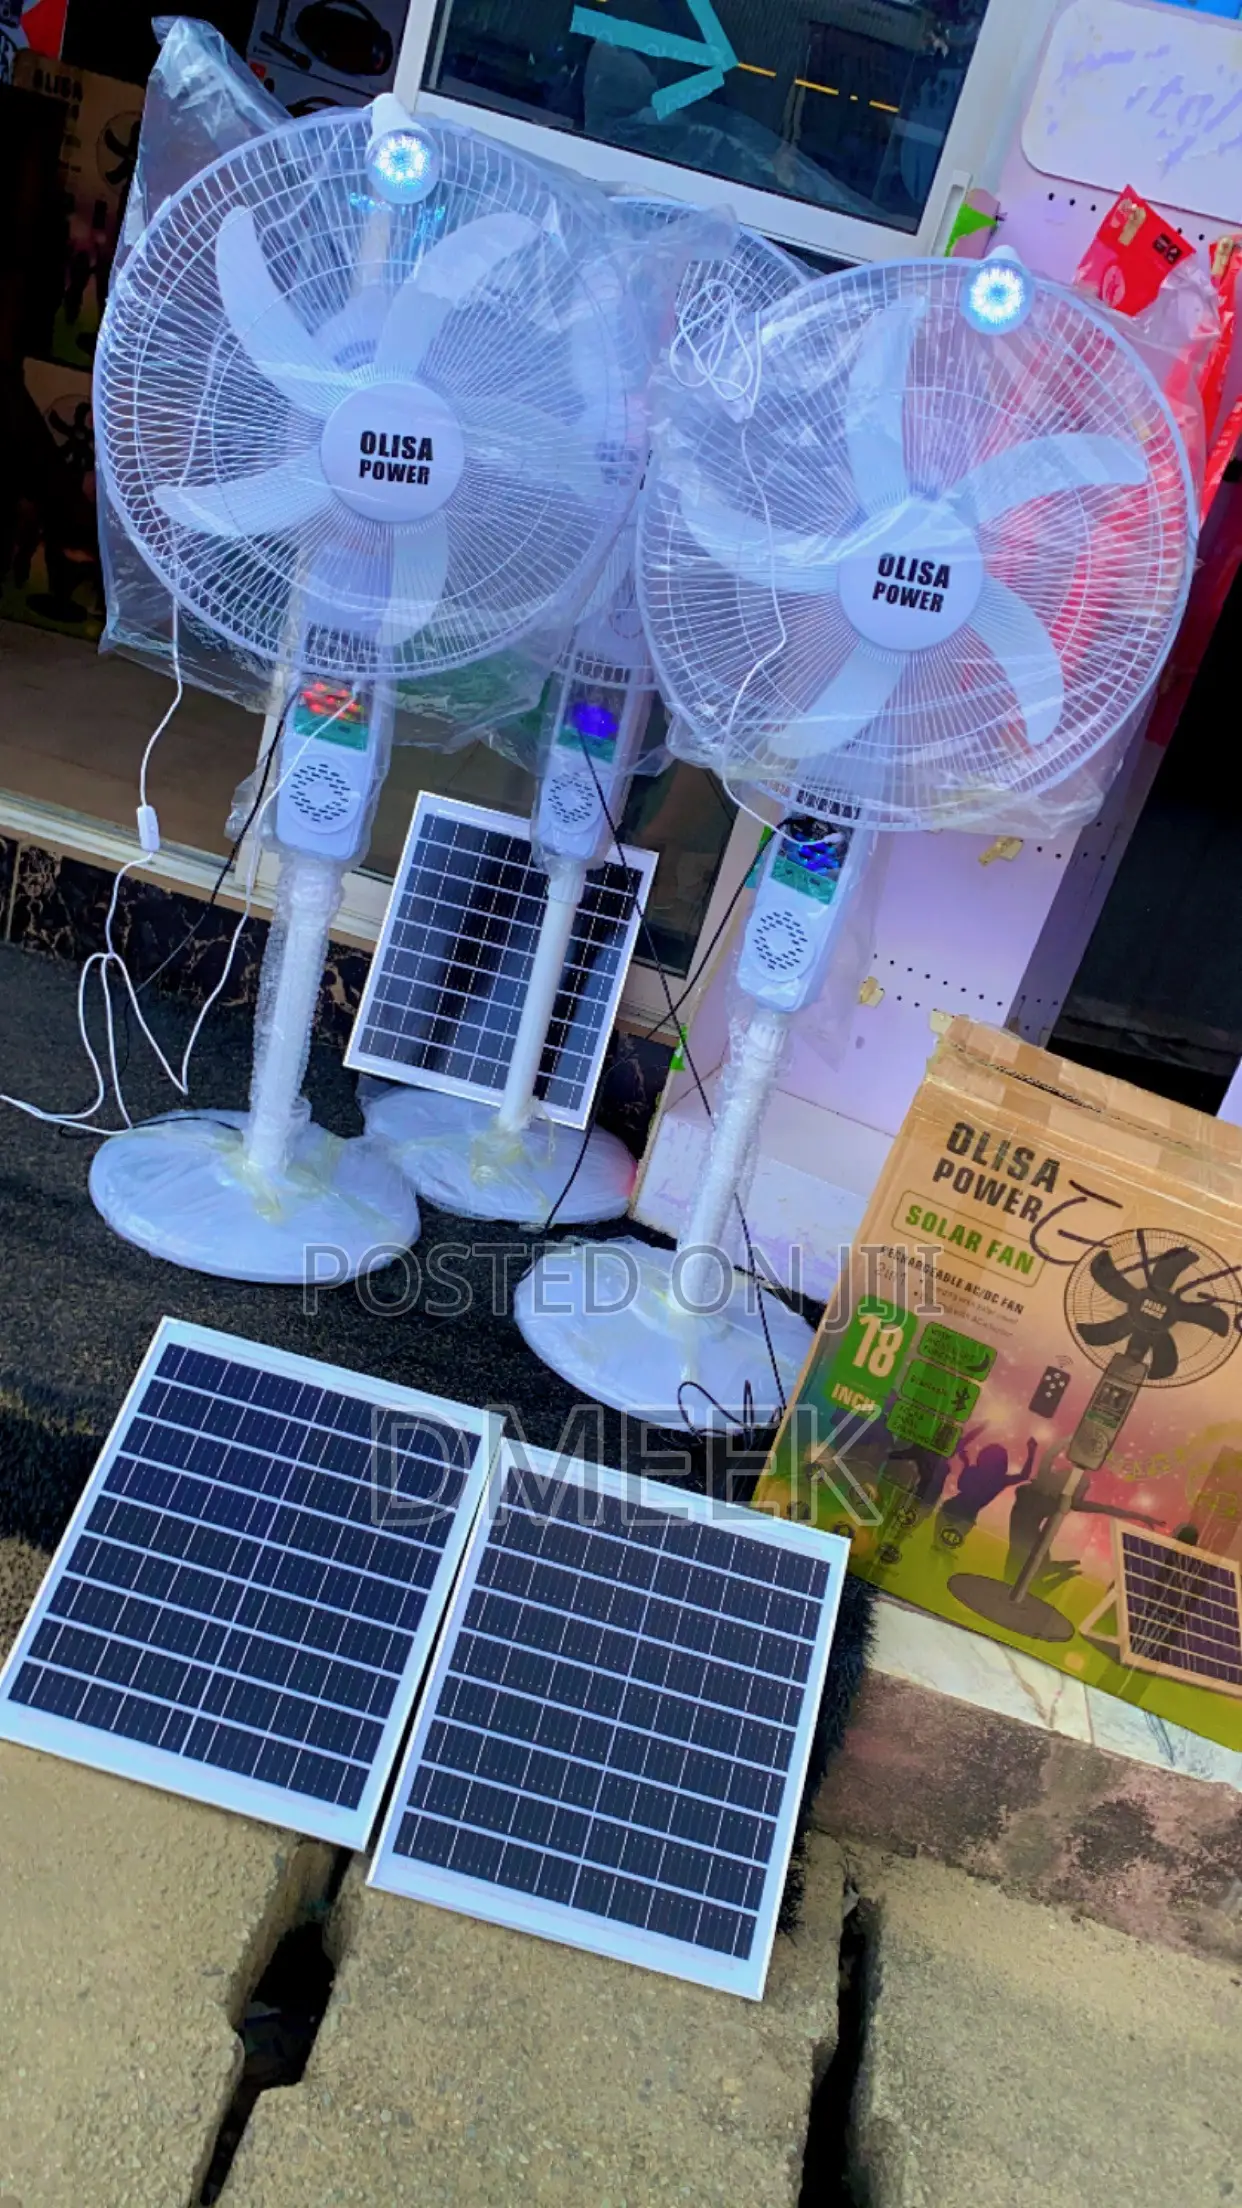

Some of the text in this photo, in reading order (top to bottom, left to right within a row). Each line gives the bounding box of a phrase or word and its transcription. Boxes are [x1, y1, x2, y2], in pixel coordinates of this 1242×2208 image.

[359, 430, 434, 462] OLISA
[358, 458, 430, 486] POWER
[877, 552, 951, 590] OLISA
[871, 580, 945, 614] POWER
[946, 1121, 1061, 1194] OLISA
[932, 1157, 1044, 1224] POWER
[904, 1203, 983, 1254] SOLAR
[985, 1238, 1036, 1276] FAN
[1000, 1294, 1025, 1316] FAN
[852, 1314, 905, 1378] 18
